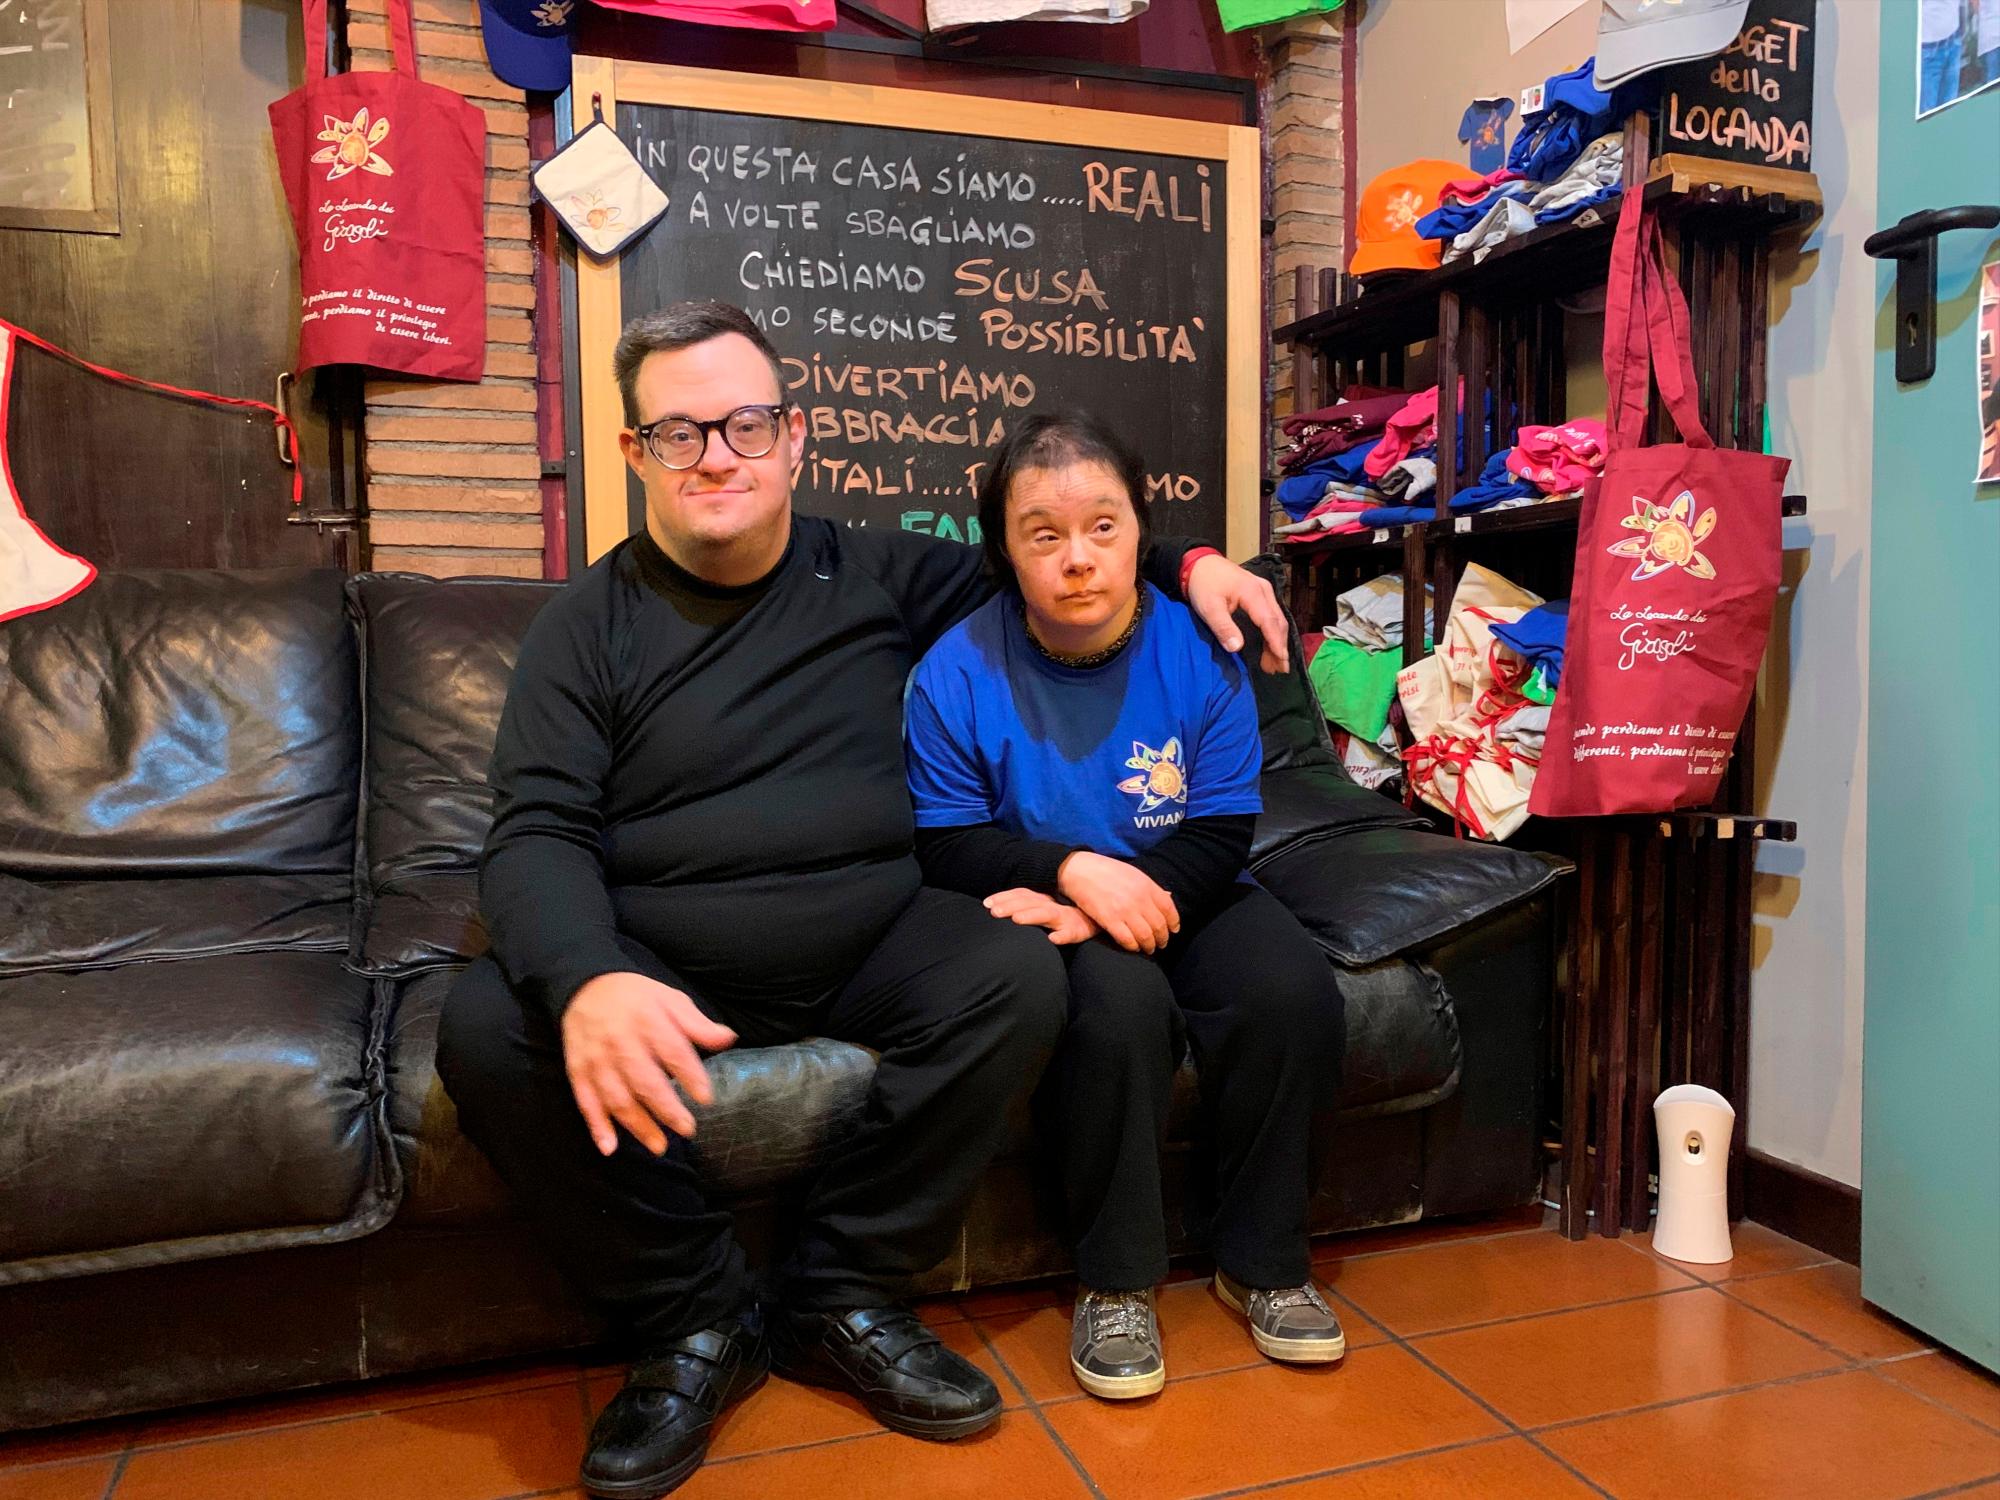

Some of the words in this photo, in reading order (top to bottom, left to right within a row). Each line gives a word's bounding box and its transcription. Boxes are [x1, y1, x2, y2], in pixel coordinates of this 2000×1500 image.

[1710, 60, 1780, 102] della
[1669, 92, 1811, 165] LOCANDA
[688, 144, 818, 185] QUESTA
[831, 155, 921, 193] CASA
[689, 190, 710, 228] A
[724, 198, 821, 230] VOLTE
[323, 213, 389, 252] Girasoli
[954, 258, 1110, 311] SCUSA
[323, 303, 372, 320] perdiamo
[375, 308, 387, 318] il
[416, 303, 446, 315] essere
[813, 306, 957, 344] SECONDE
[390, 327, 419, 340] essere
[1609, 604, 1633, 621] La
[1635, 605, 1689, 621] Locanda
[1689, 609, 1708, 623] dei
[1618, 622, 1697, 671] Girasoli
[1601, 721, 1664, 739] perdiamo
[1669, 724, 1681, 736] il
[1630, 742, 1688, 760] perdiamo
[1133, 810, 1185, 829] VIVIAN
